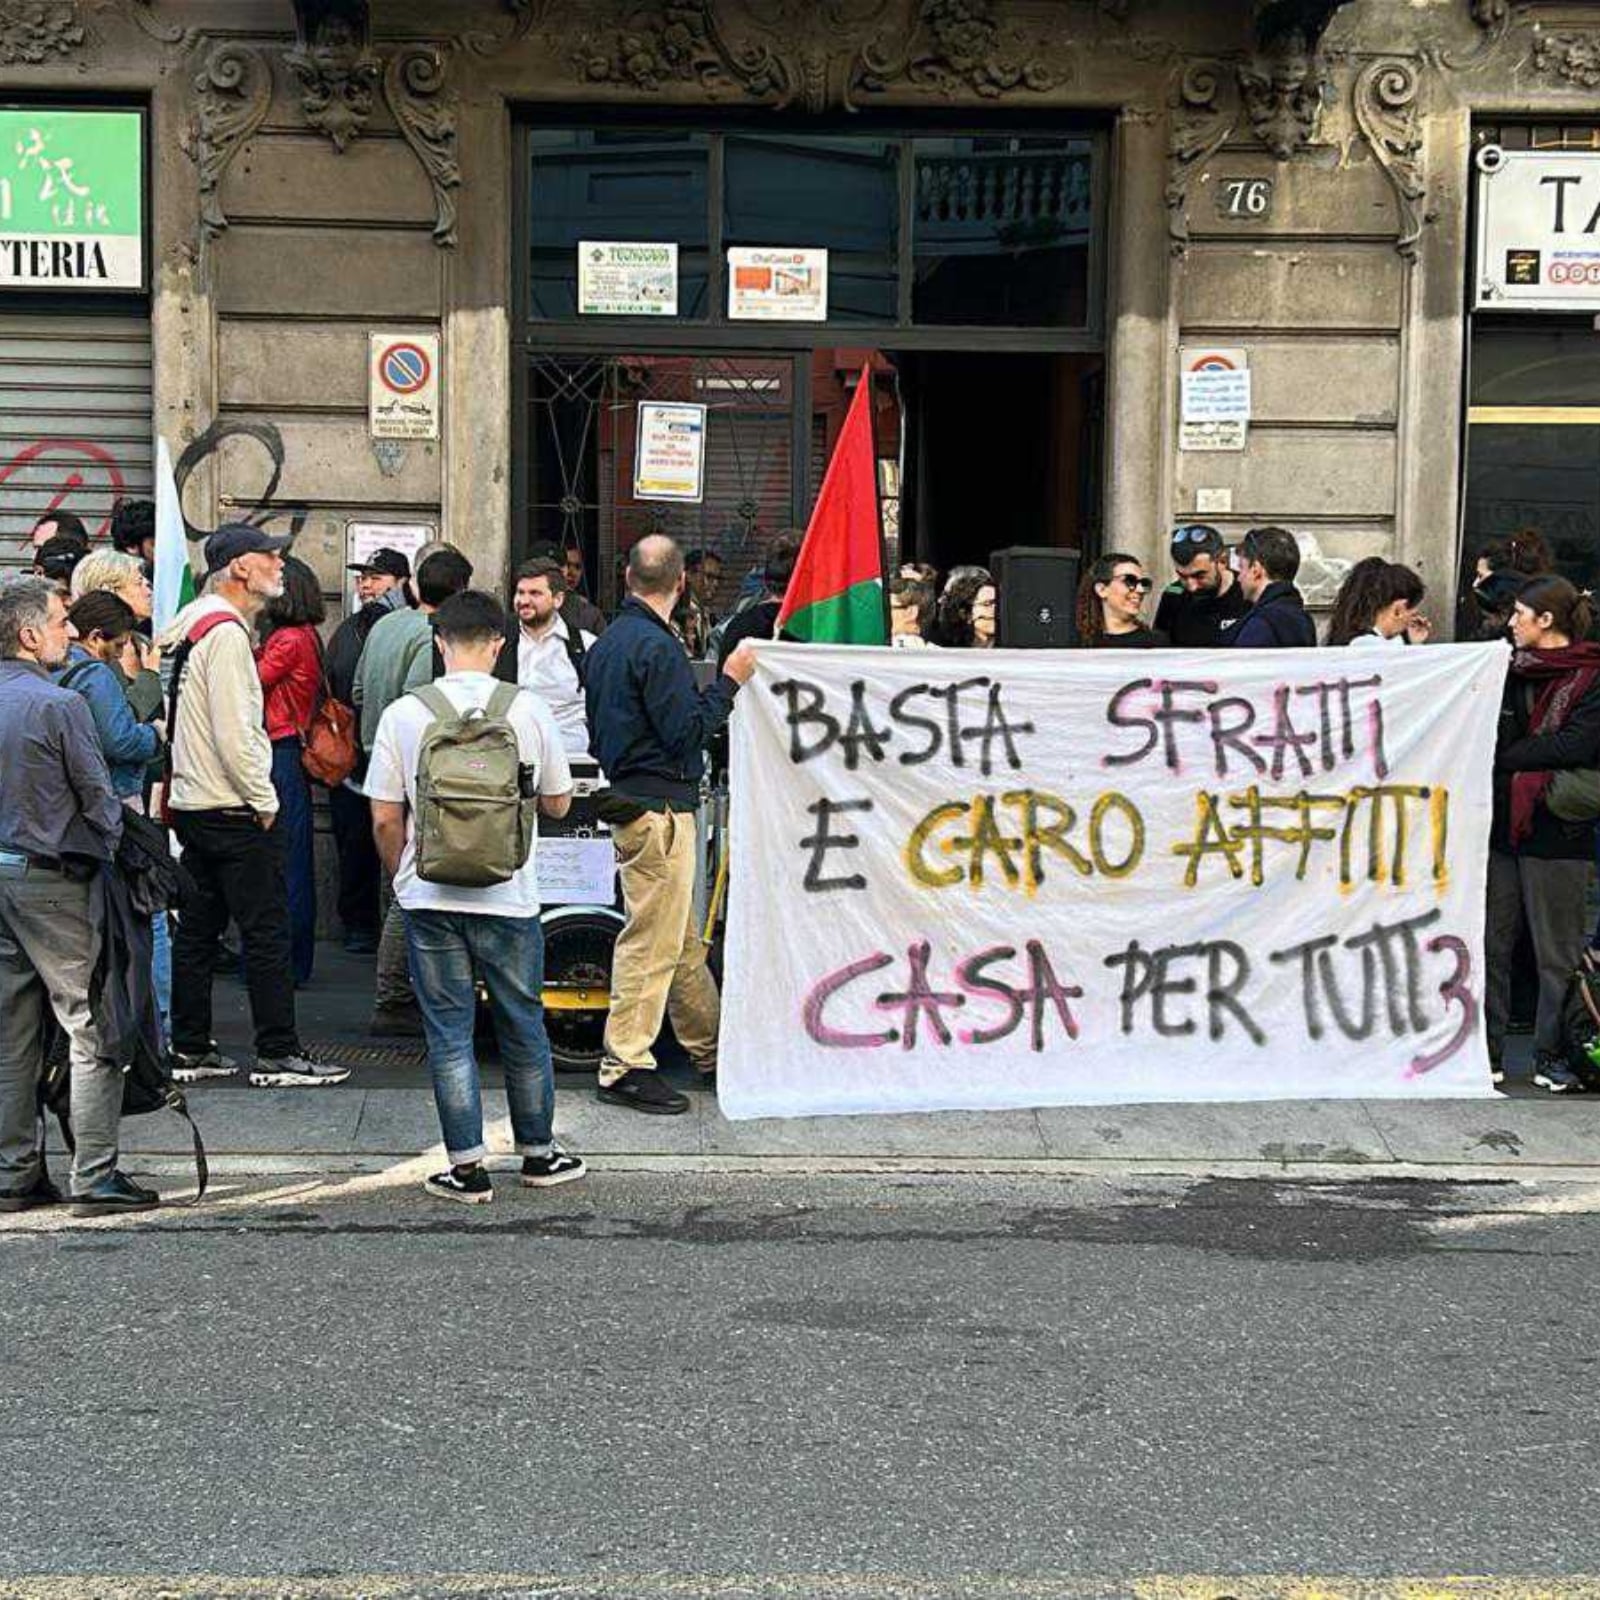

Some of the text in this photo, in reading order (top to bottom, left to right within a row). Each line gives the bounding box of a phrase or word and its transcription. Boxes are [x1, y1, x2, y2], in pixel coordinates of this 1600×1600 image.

[1227, 182, 1266, 213] 76
[0, 240, 108, 278] TERIA
[770, 674, 1389, 779] BASTA SFRATTI
[799, 784, 1450, 899] E CARO AFFITTI
[802, 939, 1083, 1052] CASA
[1104, 938, 1267, 1046] PER
